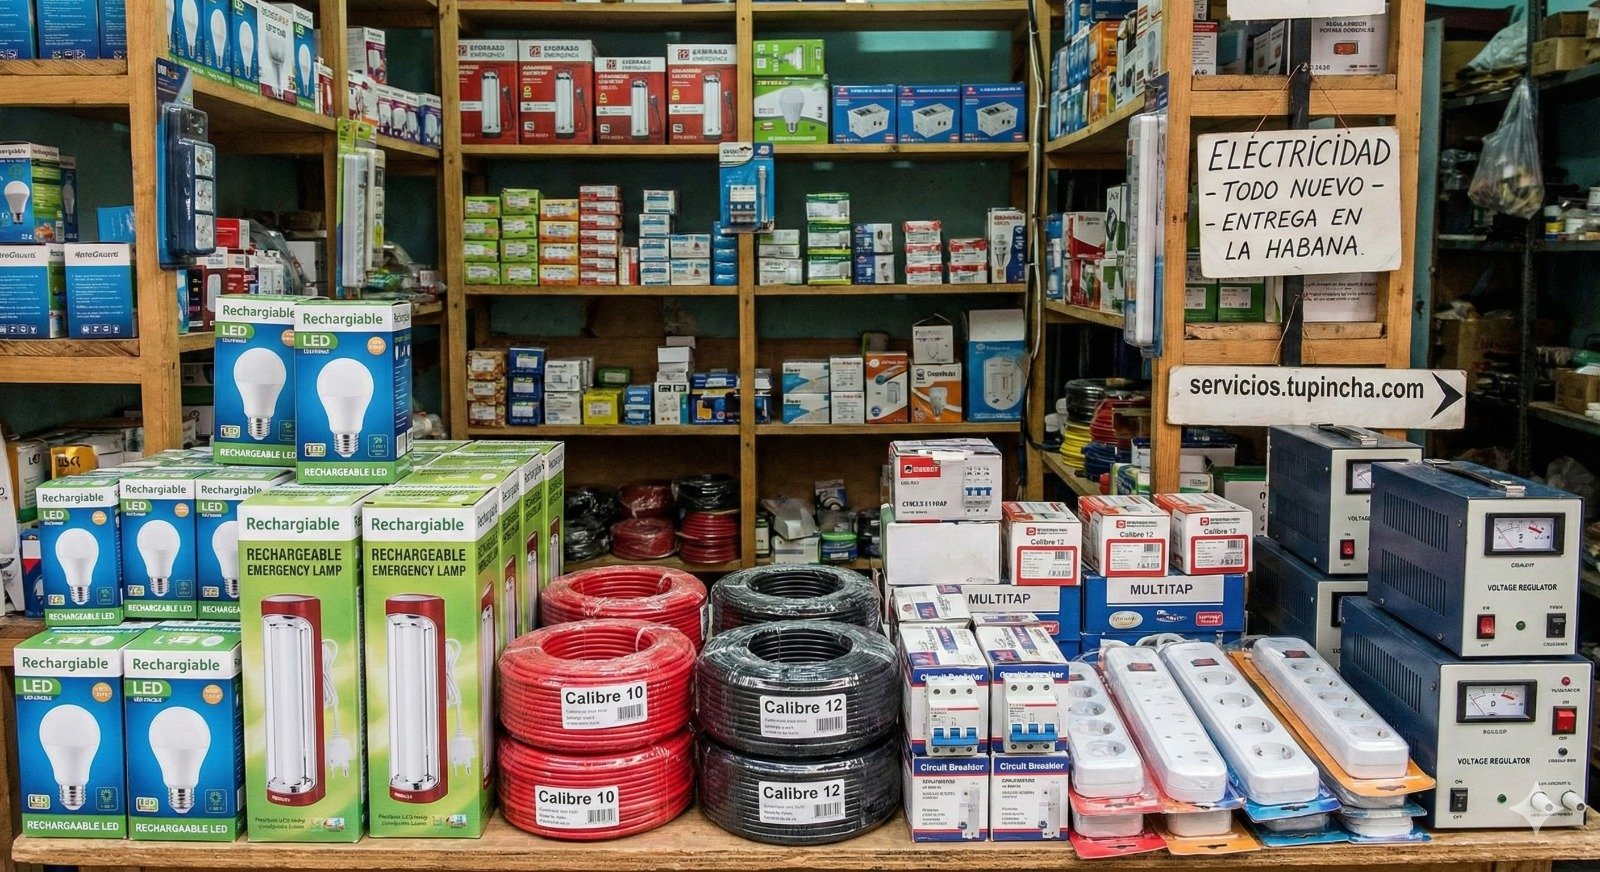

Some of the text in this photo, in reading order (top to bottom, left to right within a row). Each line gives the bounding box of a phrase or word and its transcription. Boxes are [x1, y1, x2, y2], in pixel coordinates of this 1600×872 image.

[1207, 134, 1391, 171] ELECTRICIDAD
[1222, 180, 1279, 202] TODO
[1290, 177, 1364, 199] NUEVO
[1222, 208, 1317, 231] ENTREGA
[1331, 207, 1363, 226] EN
[1225, 241, 1251, 260] LA
[222, 305, 294, 320] Rechargiable
[303, 313, 383, 327] Rechargiable
[222, 325, 248, 336] LED
[303, 335, 330, 347] LED
[1189, 374, 1424, 402] servicios.tupincha.com
[220, 449, 296, 459] RECHARGEABLE LED
[304, 468, 388, 477] RECHARGEABLE LED
[125, 485, 187, 495] Rechargiable
[201, 485, 262, 495] Rechargiable
[42, 493, 104, 504] Rechargiable
[125, 502, 147, 511] LED
[202, 502, 223, 511] LED
[43, 511, 64, 520] LED
[246, 517, 340, 534] Rechargiable
[371, 517, 464, 534] Rechargiable
[246, 548, 342, 561] RECHARGEABLE
[372, 548, 466, 562] RECHARGEABLE
[247, 565, 342, 577] EMERGENCY LAMP
[372, 565, 466, 577] EMERGENCY LAMP
[1130, 584, 1193, 595] MULTITAP
[1487, 584, 1558, 592] VOLTAGE REGULATOR
[968, 593, 1031, 605] MULTITAP
[128, 604, 193, 613] RECHARGEABLE LED
[101, 611, 115, 620] LED
[22, 656, 109, 672] Rechargiable
[132, 659, 220, 674] Rechargiable
[23, 680, 53, 693] LED
[133, 682, 163, 695] LED
[565, 685, 643, 705] Calibre 10
[764, 698, 843, 714] Calibre 12
[920, 763, 947, 771] Circuit
[1000, 762, 1027, 770] Circuit
[1457, 757, 1531, 765] VOLTAGE REGULATOR
[538, 790, 615, 805] Calibre 10
[763, 784, 840, 800] Calibre 12
[27, 820, 119, 831] RECHARGAABLE LED
[135, 823, 228, 834] RECHARGAABLE LED
